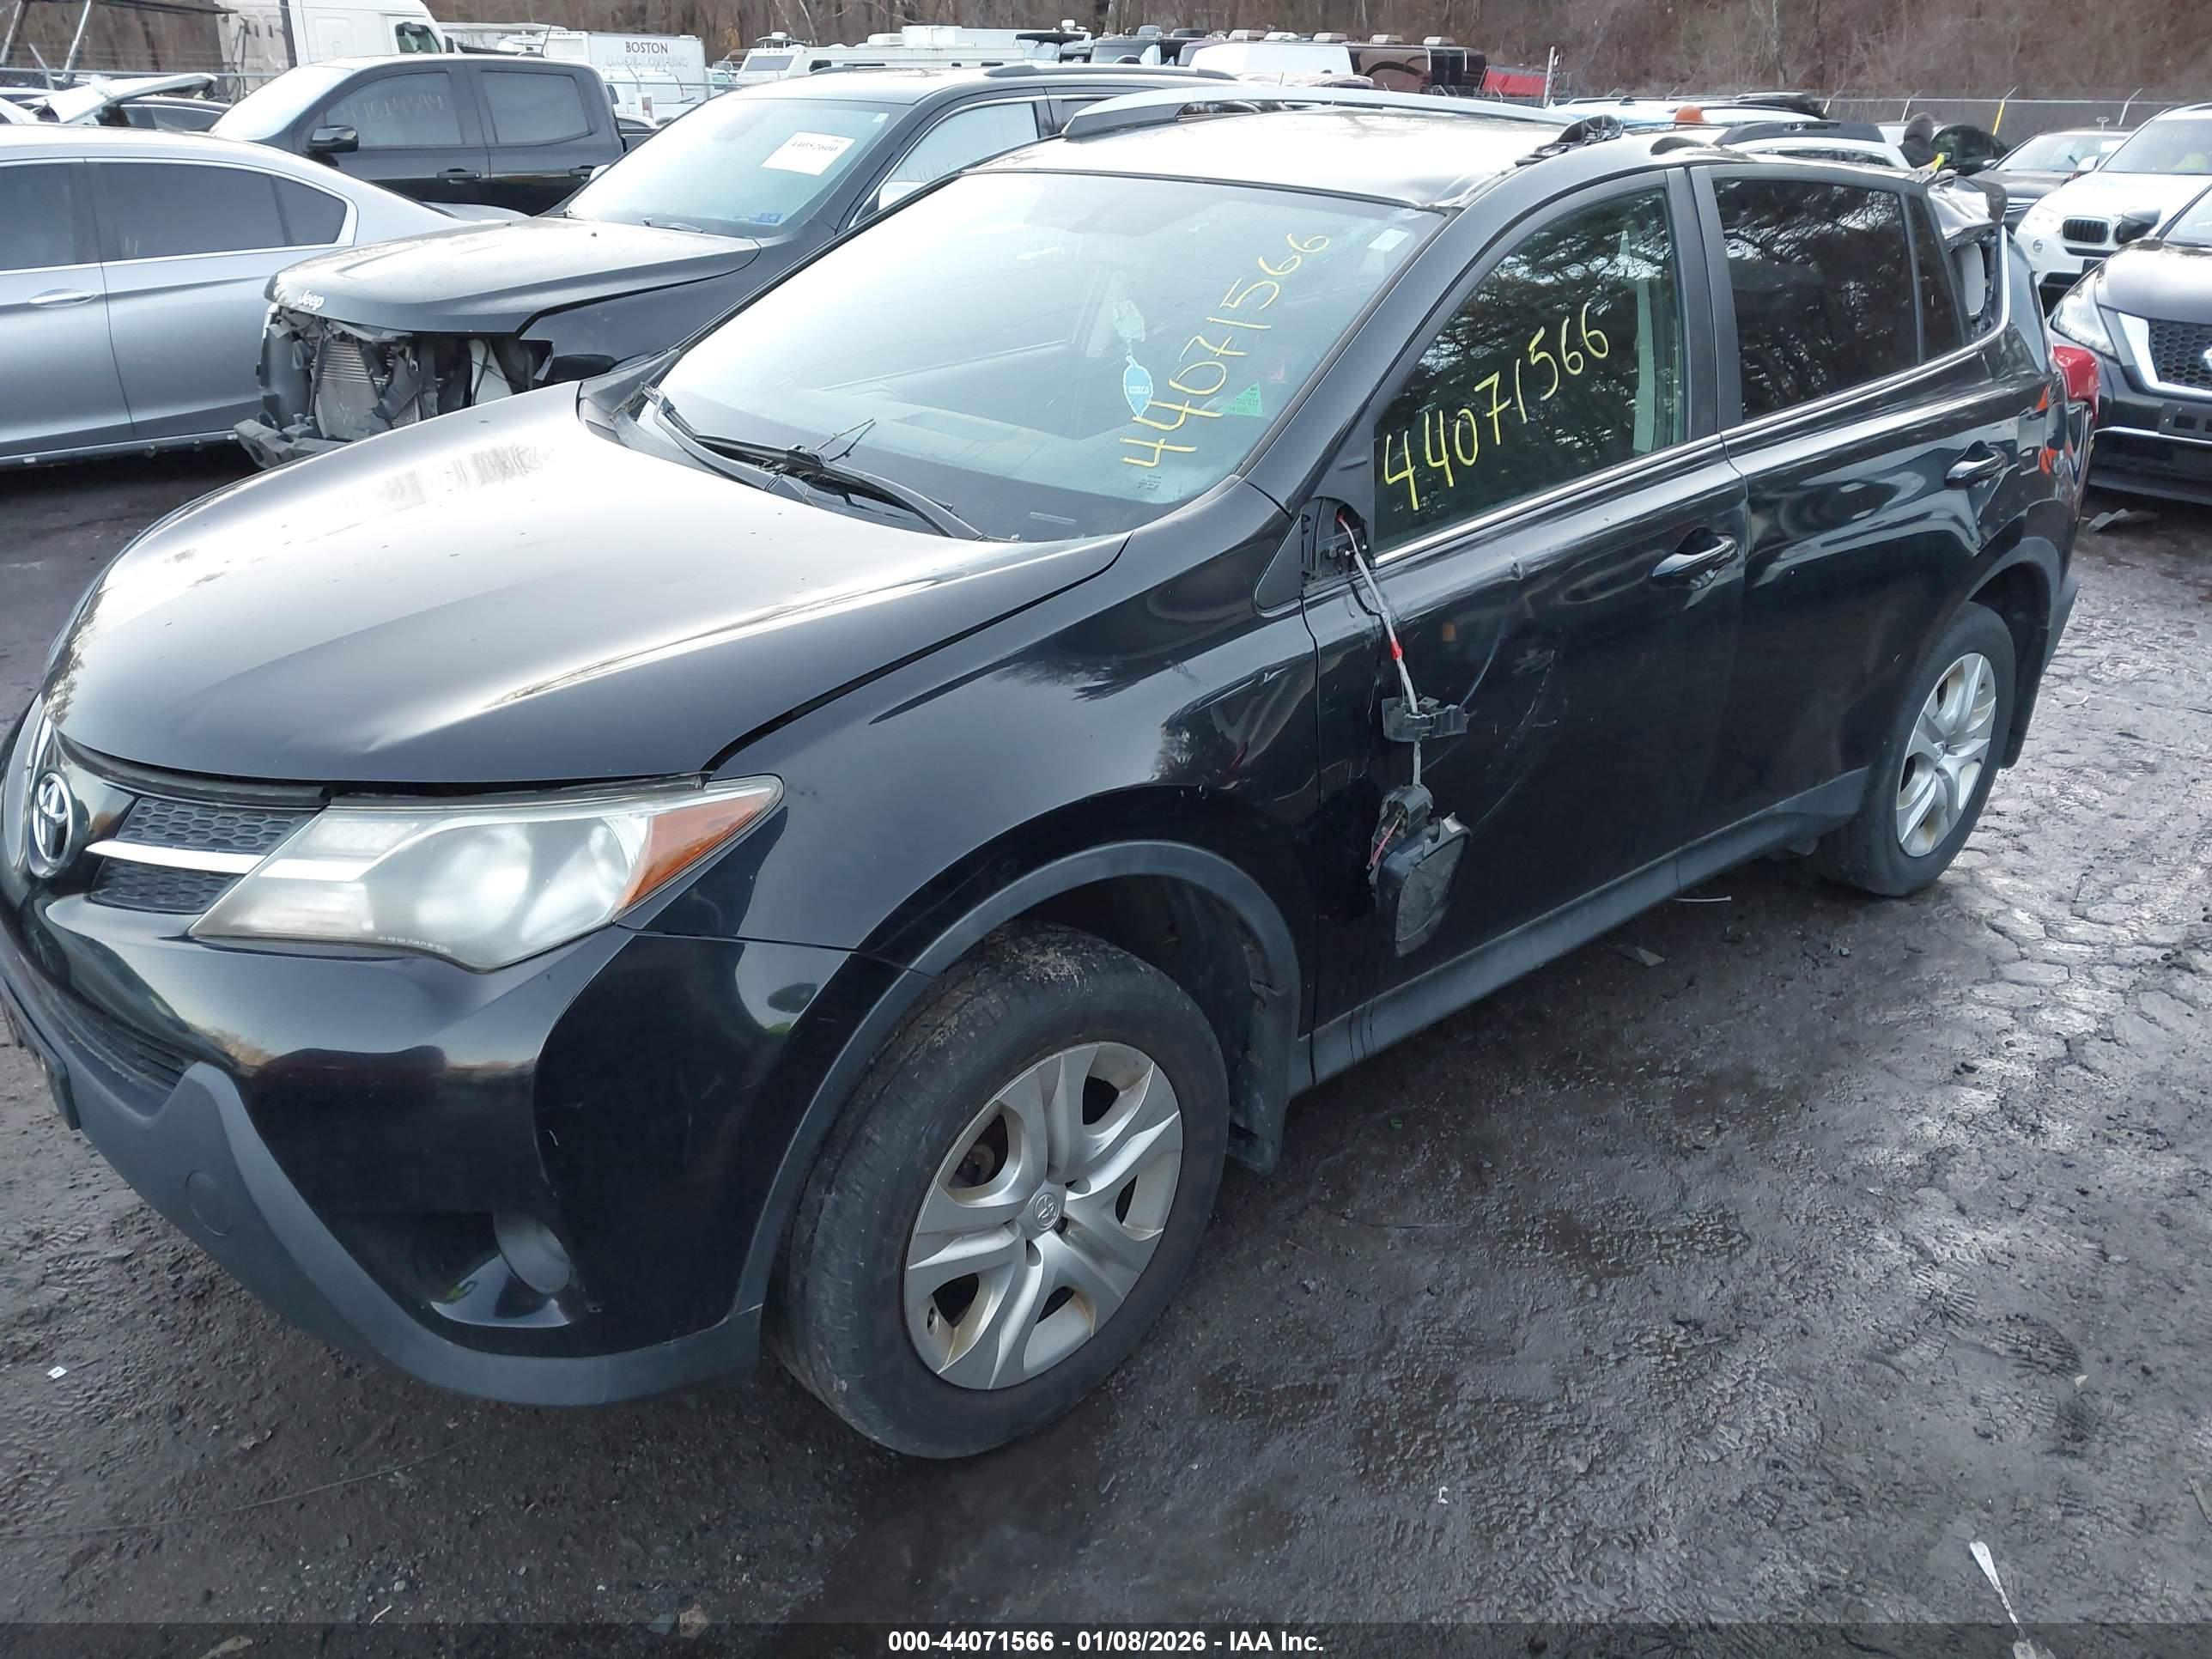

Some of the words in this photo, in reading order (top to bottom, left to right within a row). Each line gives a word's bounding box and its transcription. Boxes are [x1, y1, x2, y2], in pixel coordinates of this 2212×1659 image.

[625, 41, 669, 54] BOSTON
[297, 289, 325, 311] Jeep
[1120, 233, 1331, 468] 44071566
[1384, 301, 1609, 510] 44071566
